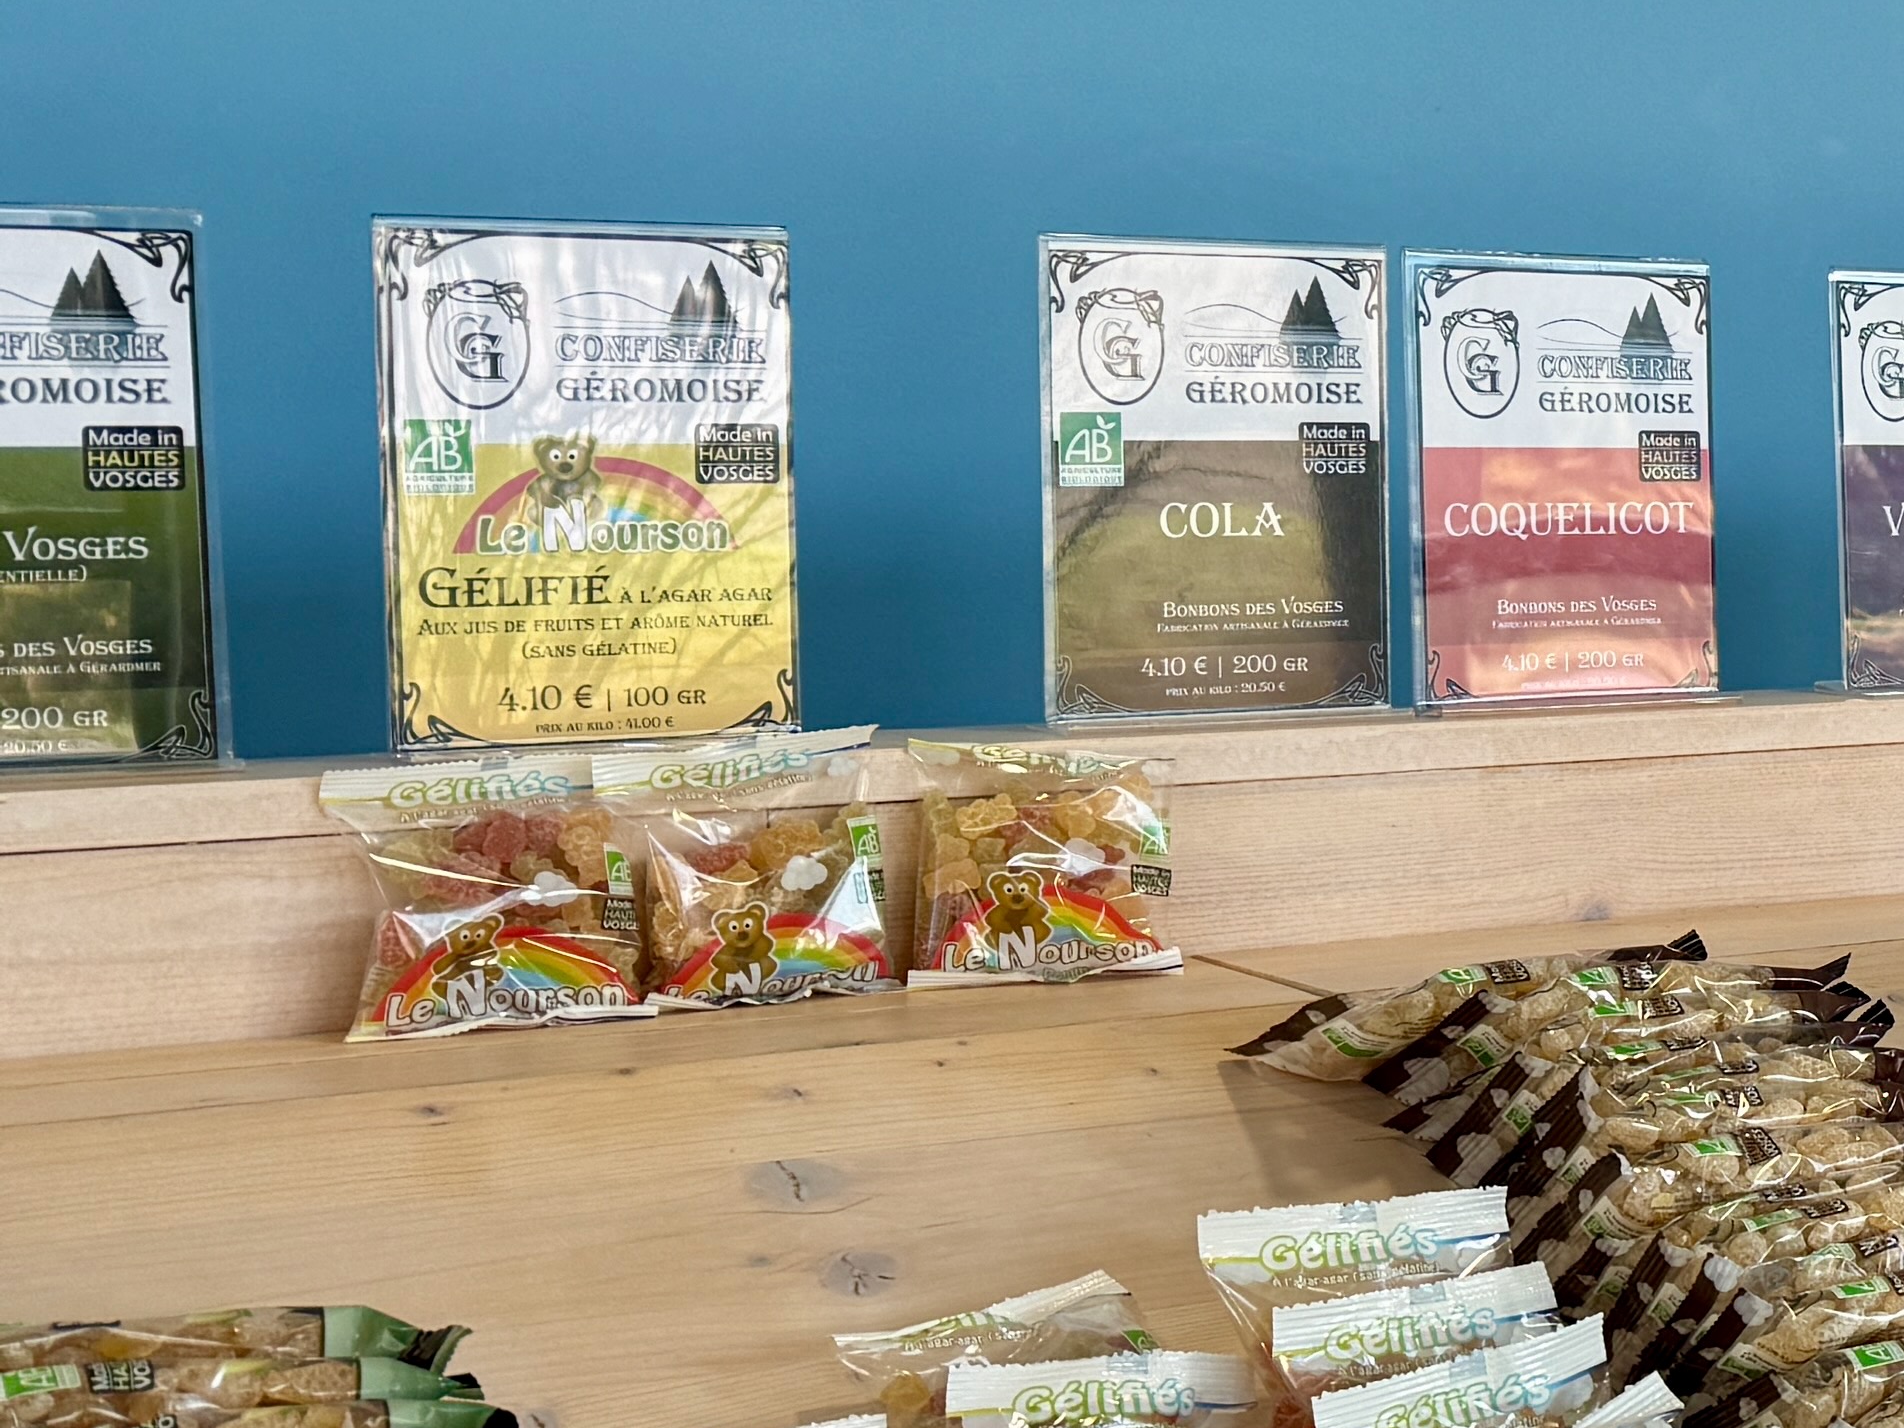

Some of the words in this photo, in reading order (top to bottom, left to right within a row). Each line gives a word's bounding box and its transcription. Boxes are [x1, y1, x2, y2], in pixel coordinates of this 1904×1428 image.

[0, 331, 168, 362] FISERIE
[555, 333, 766, 364] CONFISERIE
[1184, 342, 1362, 369] CONFISERIE
[1537, 354, 1693, 381] CONFISERIE
[556, 371, 765, 404] GÉROMOISE
[1185, 376, 1363, 404] GÉROMOISE
[1538, 387, 1694, 414] GÉROMOISE
[89, 429, 152, 446] Made
[157, 429, 176, 445] in
[699, 427, 750, 443] Made
[756, 428, 772, 442] in
[1302, 426, 1347, 438] Made
[1351, 426, 1365, 438] in
[1641, 433, 1680, 447] Made
[1684, 434, 1696, 446] in
[88, 451, 180, 467] HAUTES
[699, 446, 774, 461] HAUTES
[1302, 444, 1366, 456] HAUTES
[1641, 450, 1697, 462] HAUTES
[699, 465, 775, 481] VOSGES
[1302, 461, 1366, 474] VOSGES
[1642, 467, 1697, 480] VOSGES
[89, 471, 180, 488] VOSGES
[477, 516, 526, 554] Le
[543, 499, 729, 553] Nourson
[1159, 502, 1285, 538] COLA
[1444, 501, 1694, 541] COQUELICOT
[2, 526, 149, 561] VOSGES
[620, 587, 633, 603] À
[641, 585, 711, 602] L'AGAR
[718, 587, 772, 602] AGAR
[1280, 596, 1344, 614] VOSGES
[1601, 595, 1657, 612] VOSGES
[464, 620, 497, 634] JUS
[504, 620, 526, 632] DE
[534, 618, 595, 632] FRUITS
[601, 616, 623, 630] ET
[630, 613, 690, 629] ARÔME
[696, 613, 773, 627] NATUREL
[63, 634, 153, 656] VOSGES
[521, 643, 576, 661] (SANS
[582, 636, 678, 656] GÉLATINE)
[1141, 657, 1186, 677] 4.10
[1194, 657, 1208, 675] €
[1232, 655, 1276, 674] 200
[1502, 653, 1539, 672] 4.10
[1545, 654, 1557, 669] €
[1578, 651, 1616, 669] 200
[498, 684, 561, 712] 4.10
[574, 684, 593, 709] €
[625, 685, 669, 707] 100
[1, 706, 63, 729] 200
[566, 721, 582, 732] AU
[387, 770, 570, 809] Gélifiés
[942, 942, 986, 973] Le
[998, 925, 1154, 971] Nourson
[384, 992, 437, 1028] Le
[446, 968, 628, 1019] Nourson
[1259, 1223, 1440, 1272] Gélifiés
[1012, 1377, 1197, 1424] Gélifiés
